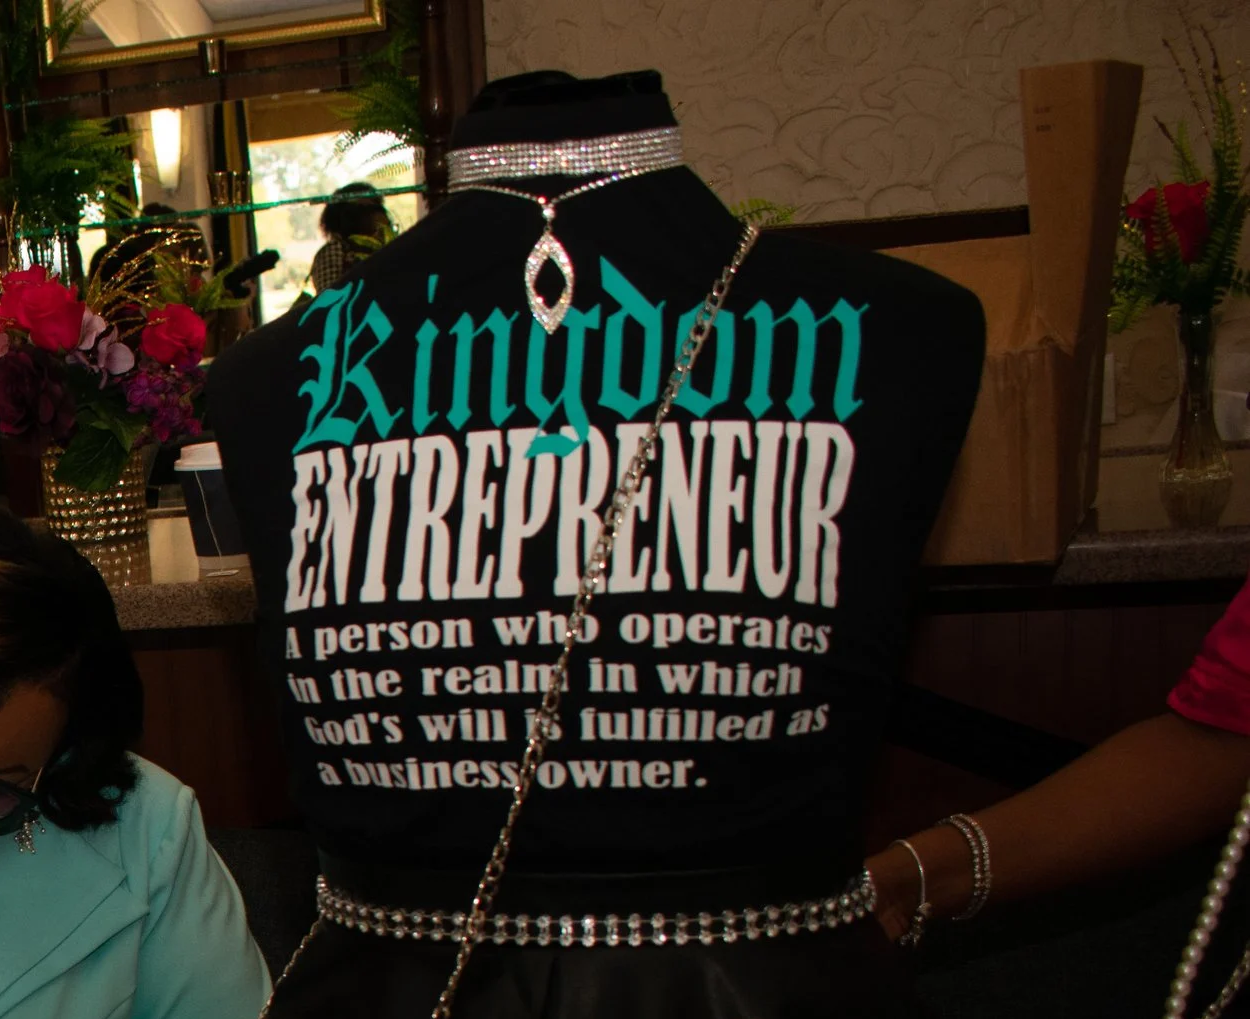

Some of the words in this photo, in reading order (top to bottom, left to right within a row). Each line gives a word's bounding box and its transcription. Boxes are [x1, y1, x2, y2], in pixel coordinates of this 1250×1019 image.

[293, 255, 869, 460] Kingdom
[285, 420, 854, 613] ENTREPRENEUR
[285, 626, 302, 660] A
[313, 617, 473, 662] person
[492, 610, 599, 645] who
[619, 612, 832, 655] operates
[287, 672, 322, 704] in
[330, 665, 403, 699] the
[421, 660, 570, 697] realm
[588, 659, 638, 694] in
[656, 660, 803, 698] which
[304, 710, 404, 747] God's
[421, 708, 507, 743] will
[525, 708, 563, 743] is
[579, 708, 774, 743] fulfilled
[786, 703, 832, 735] as
[317, 759, 344, 787] a
[349, 757, 519, 791] business
[536, 758, 708, 789] owner.
